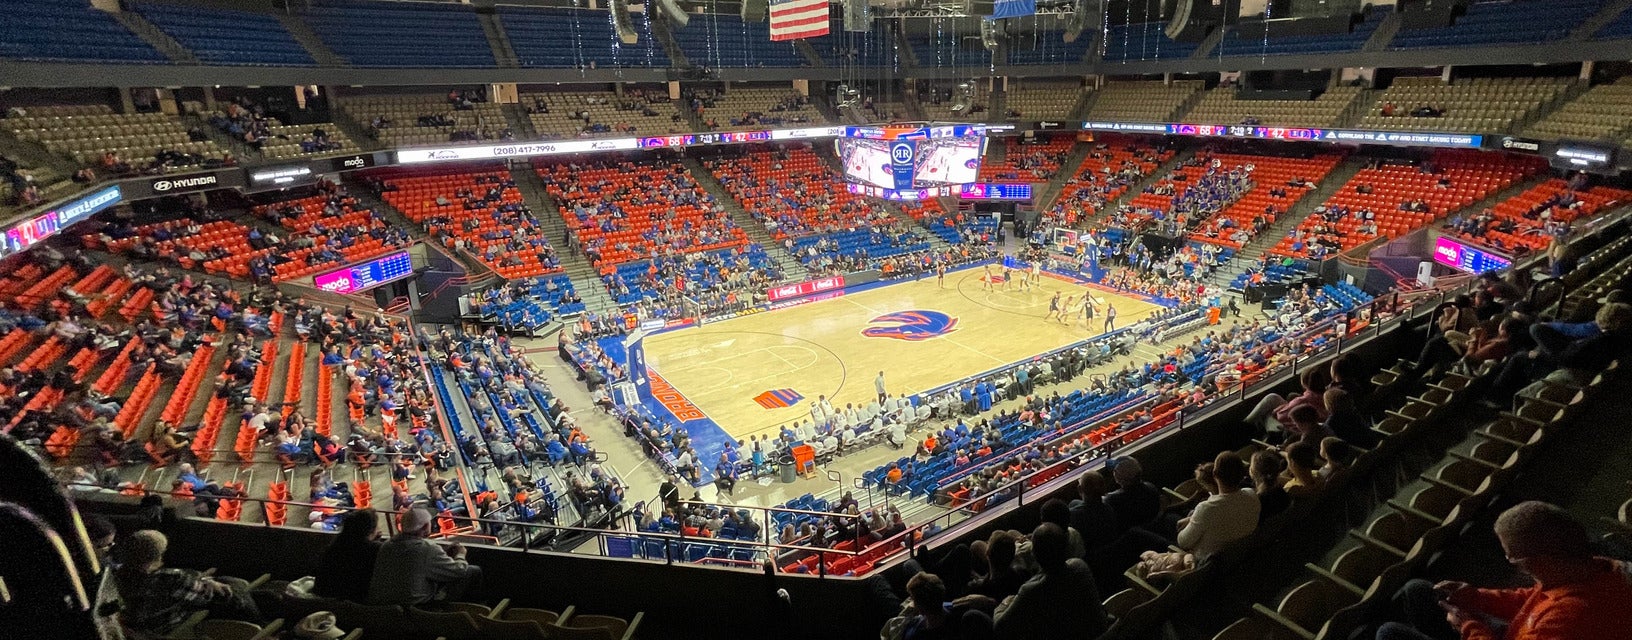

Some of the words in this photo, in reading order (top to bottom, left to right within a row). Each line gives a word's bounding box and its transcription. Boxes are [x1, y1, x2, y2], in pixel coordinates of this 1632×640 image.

[1200, 125, 1210, 135] 68
[1272, 127, 1284, 138] 42
[669, 136, 680, 146] 68
[736, 133, 746, 142] 42
[493, 147, 517, 156] (208)
[518, 145, 556, 154] 417-7996
[344, 156, 364, 167] moda
[173, 175, 216, 189] HYUNDAI
[23, 221, 37, 244] 42
[1438, 245, 1457, 258] moda
